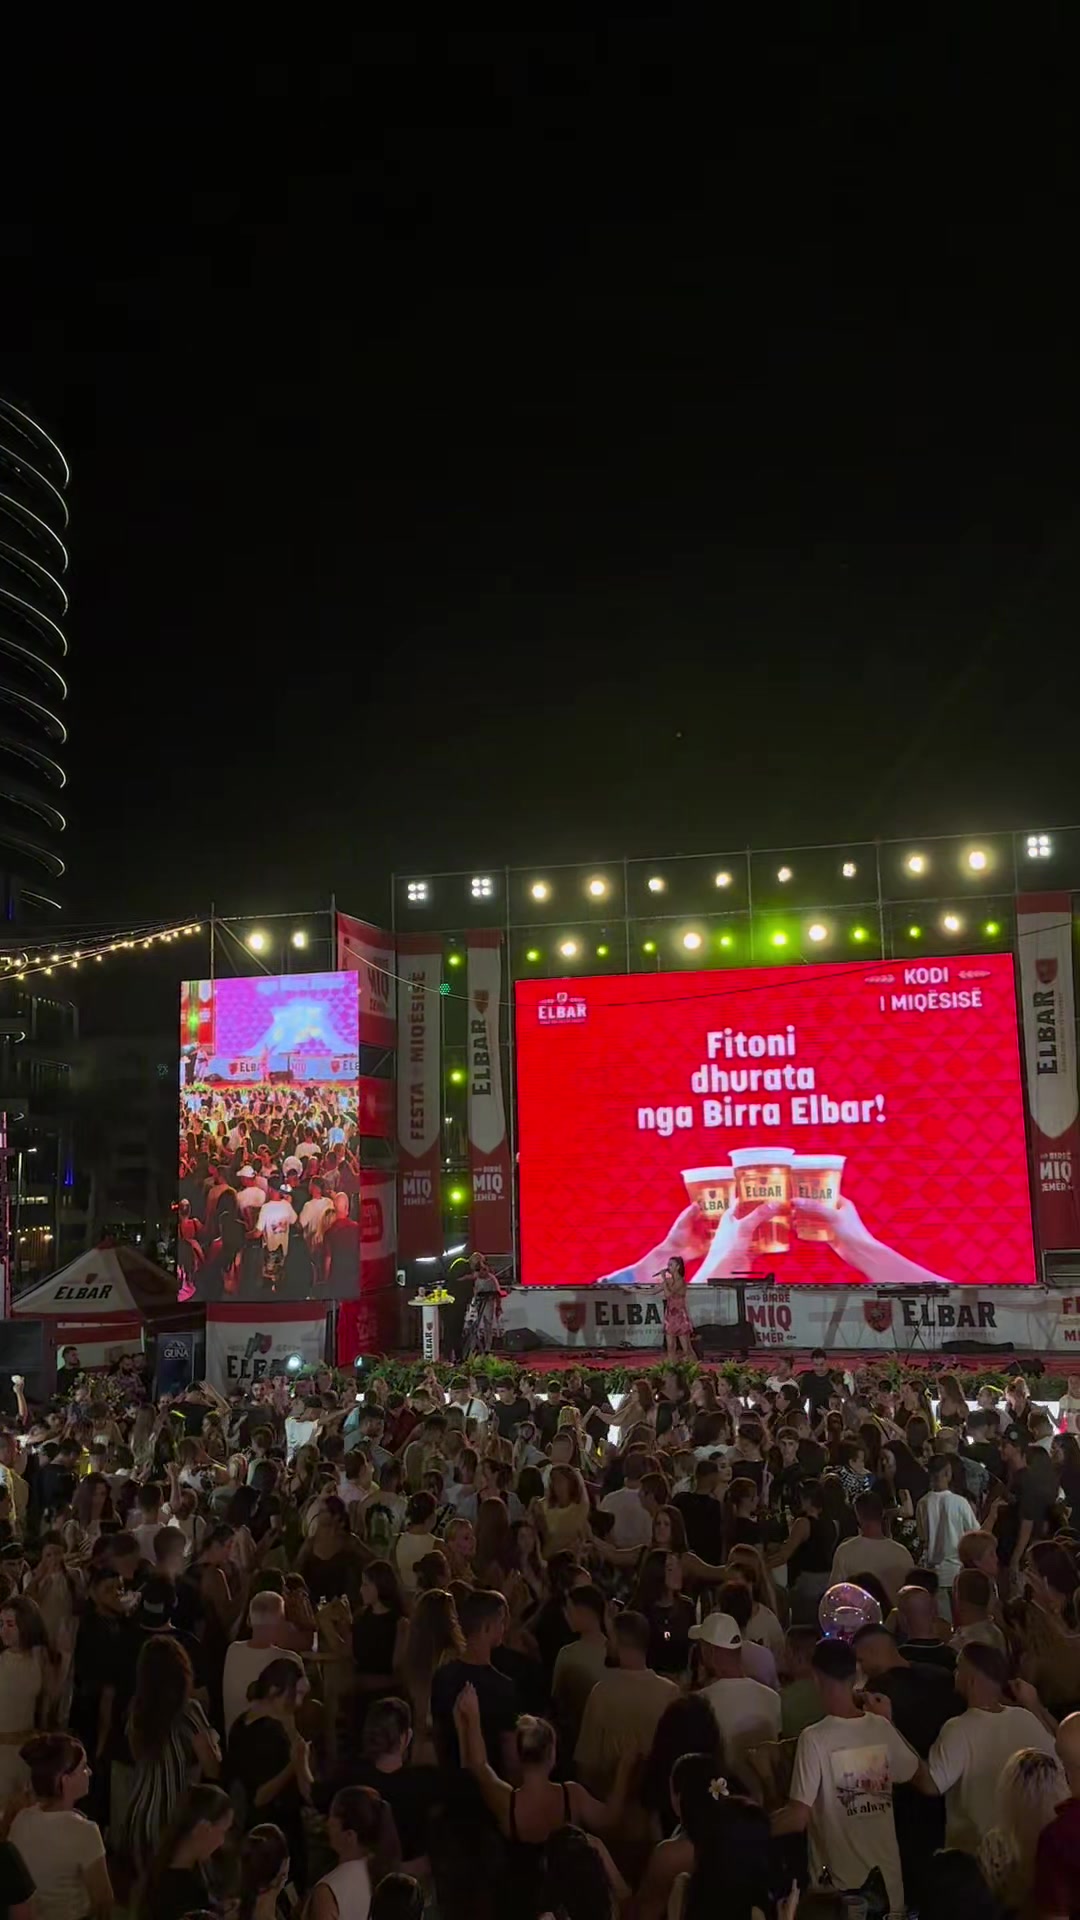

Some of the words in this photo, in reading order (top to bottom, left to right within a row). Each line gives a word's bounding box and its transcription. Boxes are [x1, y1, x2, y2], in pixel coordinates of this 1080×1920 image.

[903, 966, 950, 985] KODI
[537, 1002, 588, 1020] ELBAR
[879, 995, 886, 1012] I
[890, 986, 983, 1013] MIQËSISË
[706, 1024, 797, 1059] Fitoni
[1032, 988, 1058, 1075] ELBAR
[470, 1018, 491, 1096] ELBAR
[690, 1063, 816, 1094] dhurata
[410, 1082, 425, 1140] FESTA
[637, 1105, 694, 1137] nga
[702, 1095, 781, 1128] Birra
[790, 1093, 887, 1125] Elbar!
[472, 1173, 504, 1194] MIQ
[1040, 1160, 1072, 1183] MIQ
[402, 1178, 432, 1199] MIQ
[745, 1185, 782, 1198] ELBAR
[798, 1186, 833, 1200] ELBAR
[53, 1284, 113, 1300] ELBAR
[746, 1304, 792, 1332] MIQ
[900, 1299, 998, 1329] ELBAR
[425, 1331, 433, 1359] ELBAR
